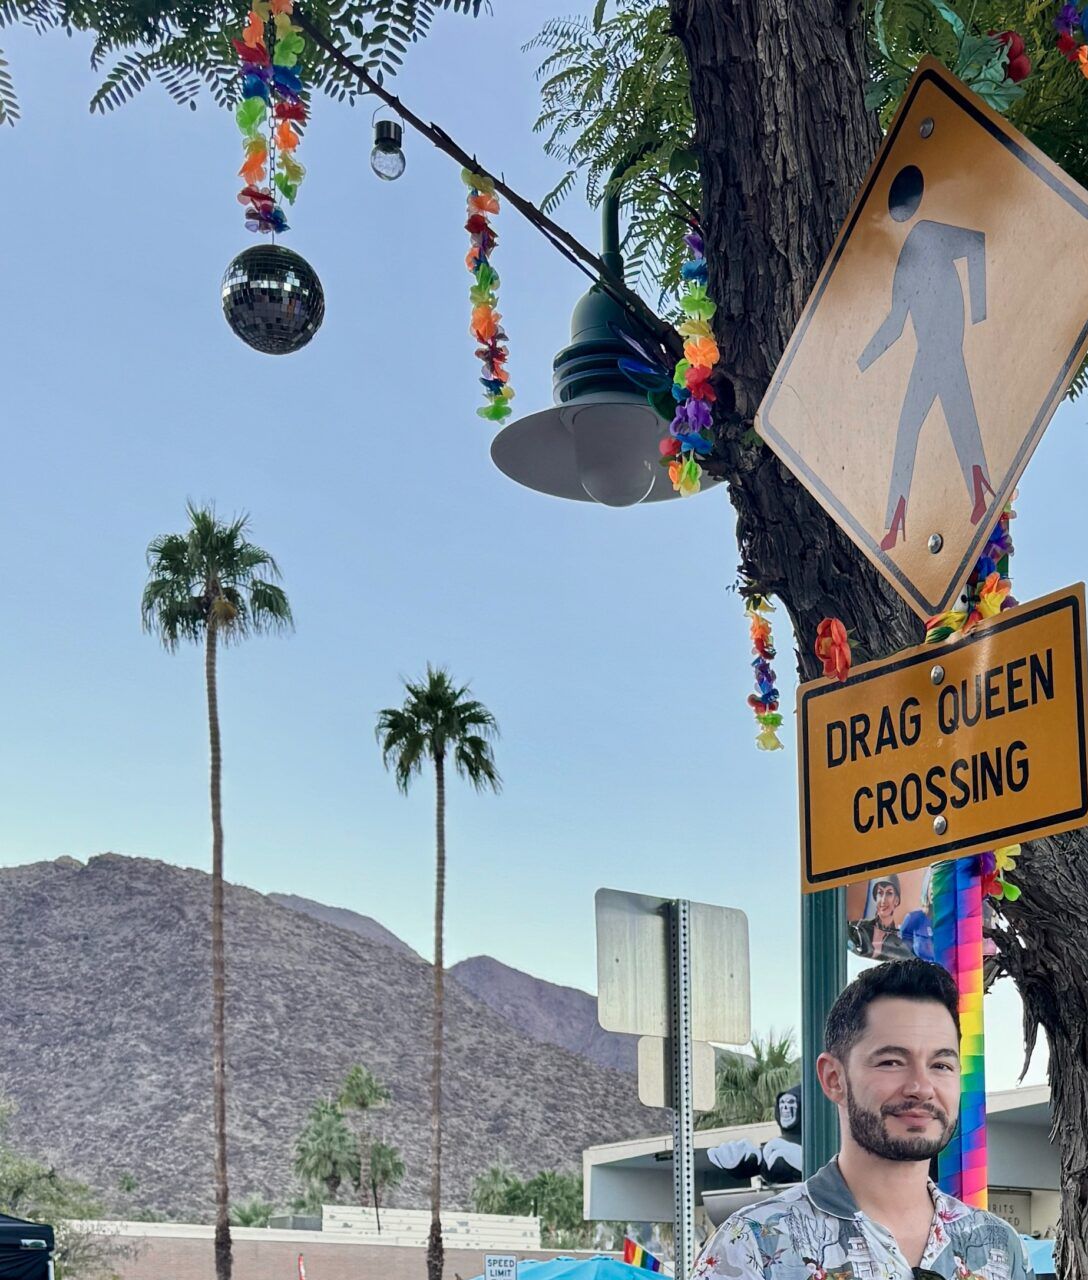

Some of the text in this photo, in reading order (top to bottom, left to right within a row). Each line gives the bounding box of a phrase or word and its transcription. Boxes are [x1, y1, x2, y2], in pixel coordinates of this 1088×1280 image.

[826, 648, 1055, 769] DRAG QUEEN
[853, 740, 1030, 834] CROSSING
[992, 1204, 1014, 1214] RITS
[487, 1259, 515, 1268] SPEED
[490, 1269, 512, 1277] LIMIT
